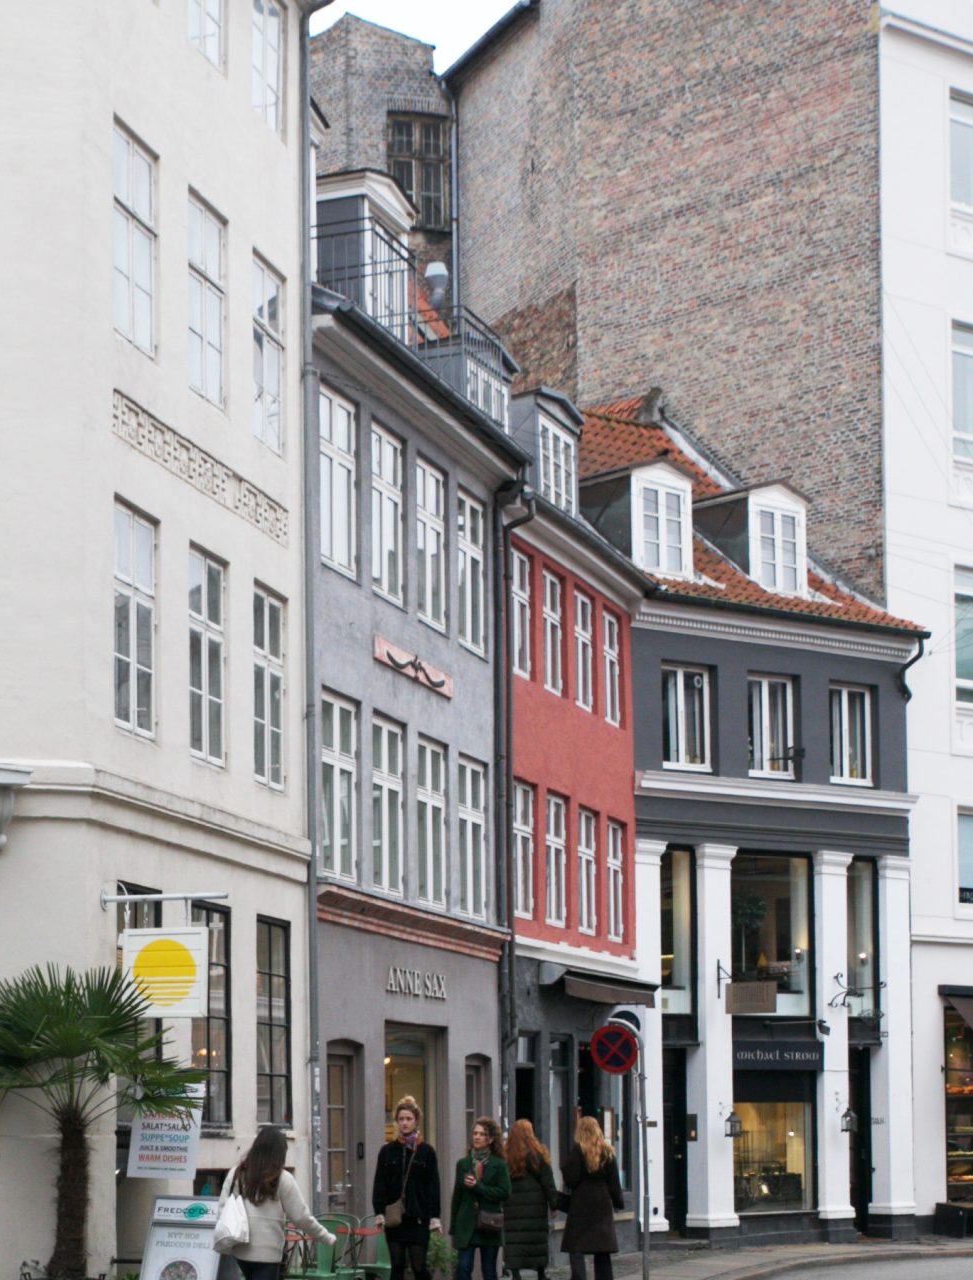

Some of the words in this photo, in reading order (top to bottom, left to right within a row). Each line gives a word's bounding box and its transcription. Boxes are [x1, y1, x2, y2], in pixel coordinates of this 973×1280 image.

[386, 966, 422, 995] ANNE
[424, 972, 447, 999] SAX
[160, 1145, 188, 1153] SMOOTHIE
[138, 1154, 161, 1162] WARM
[162, 1155, 188, 1164] DISHES
